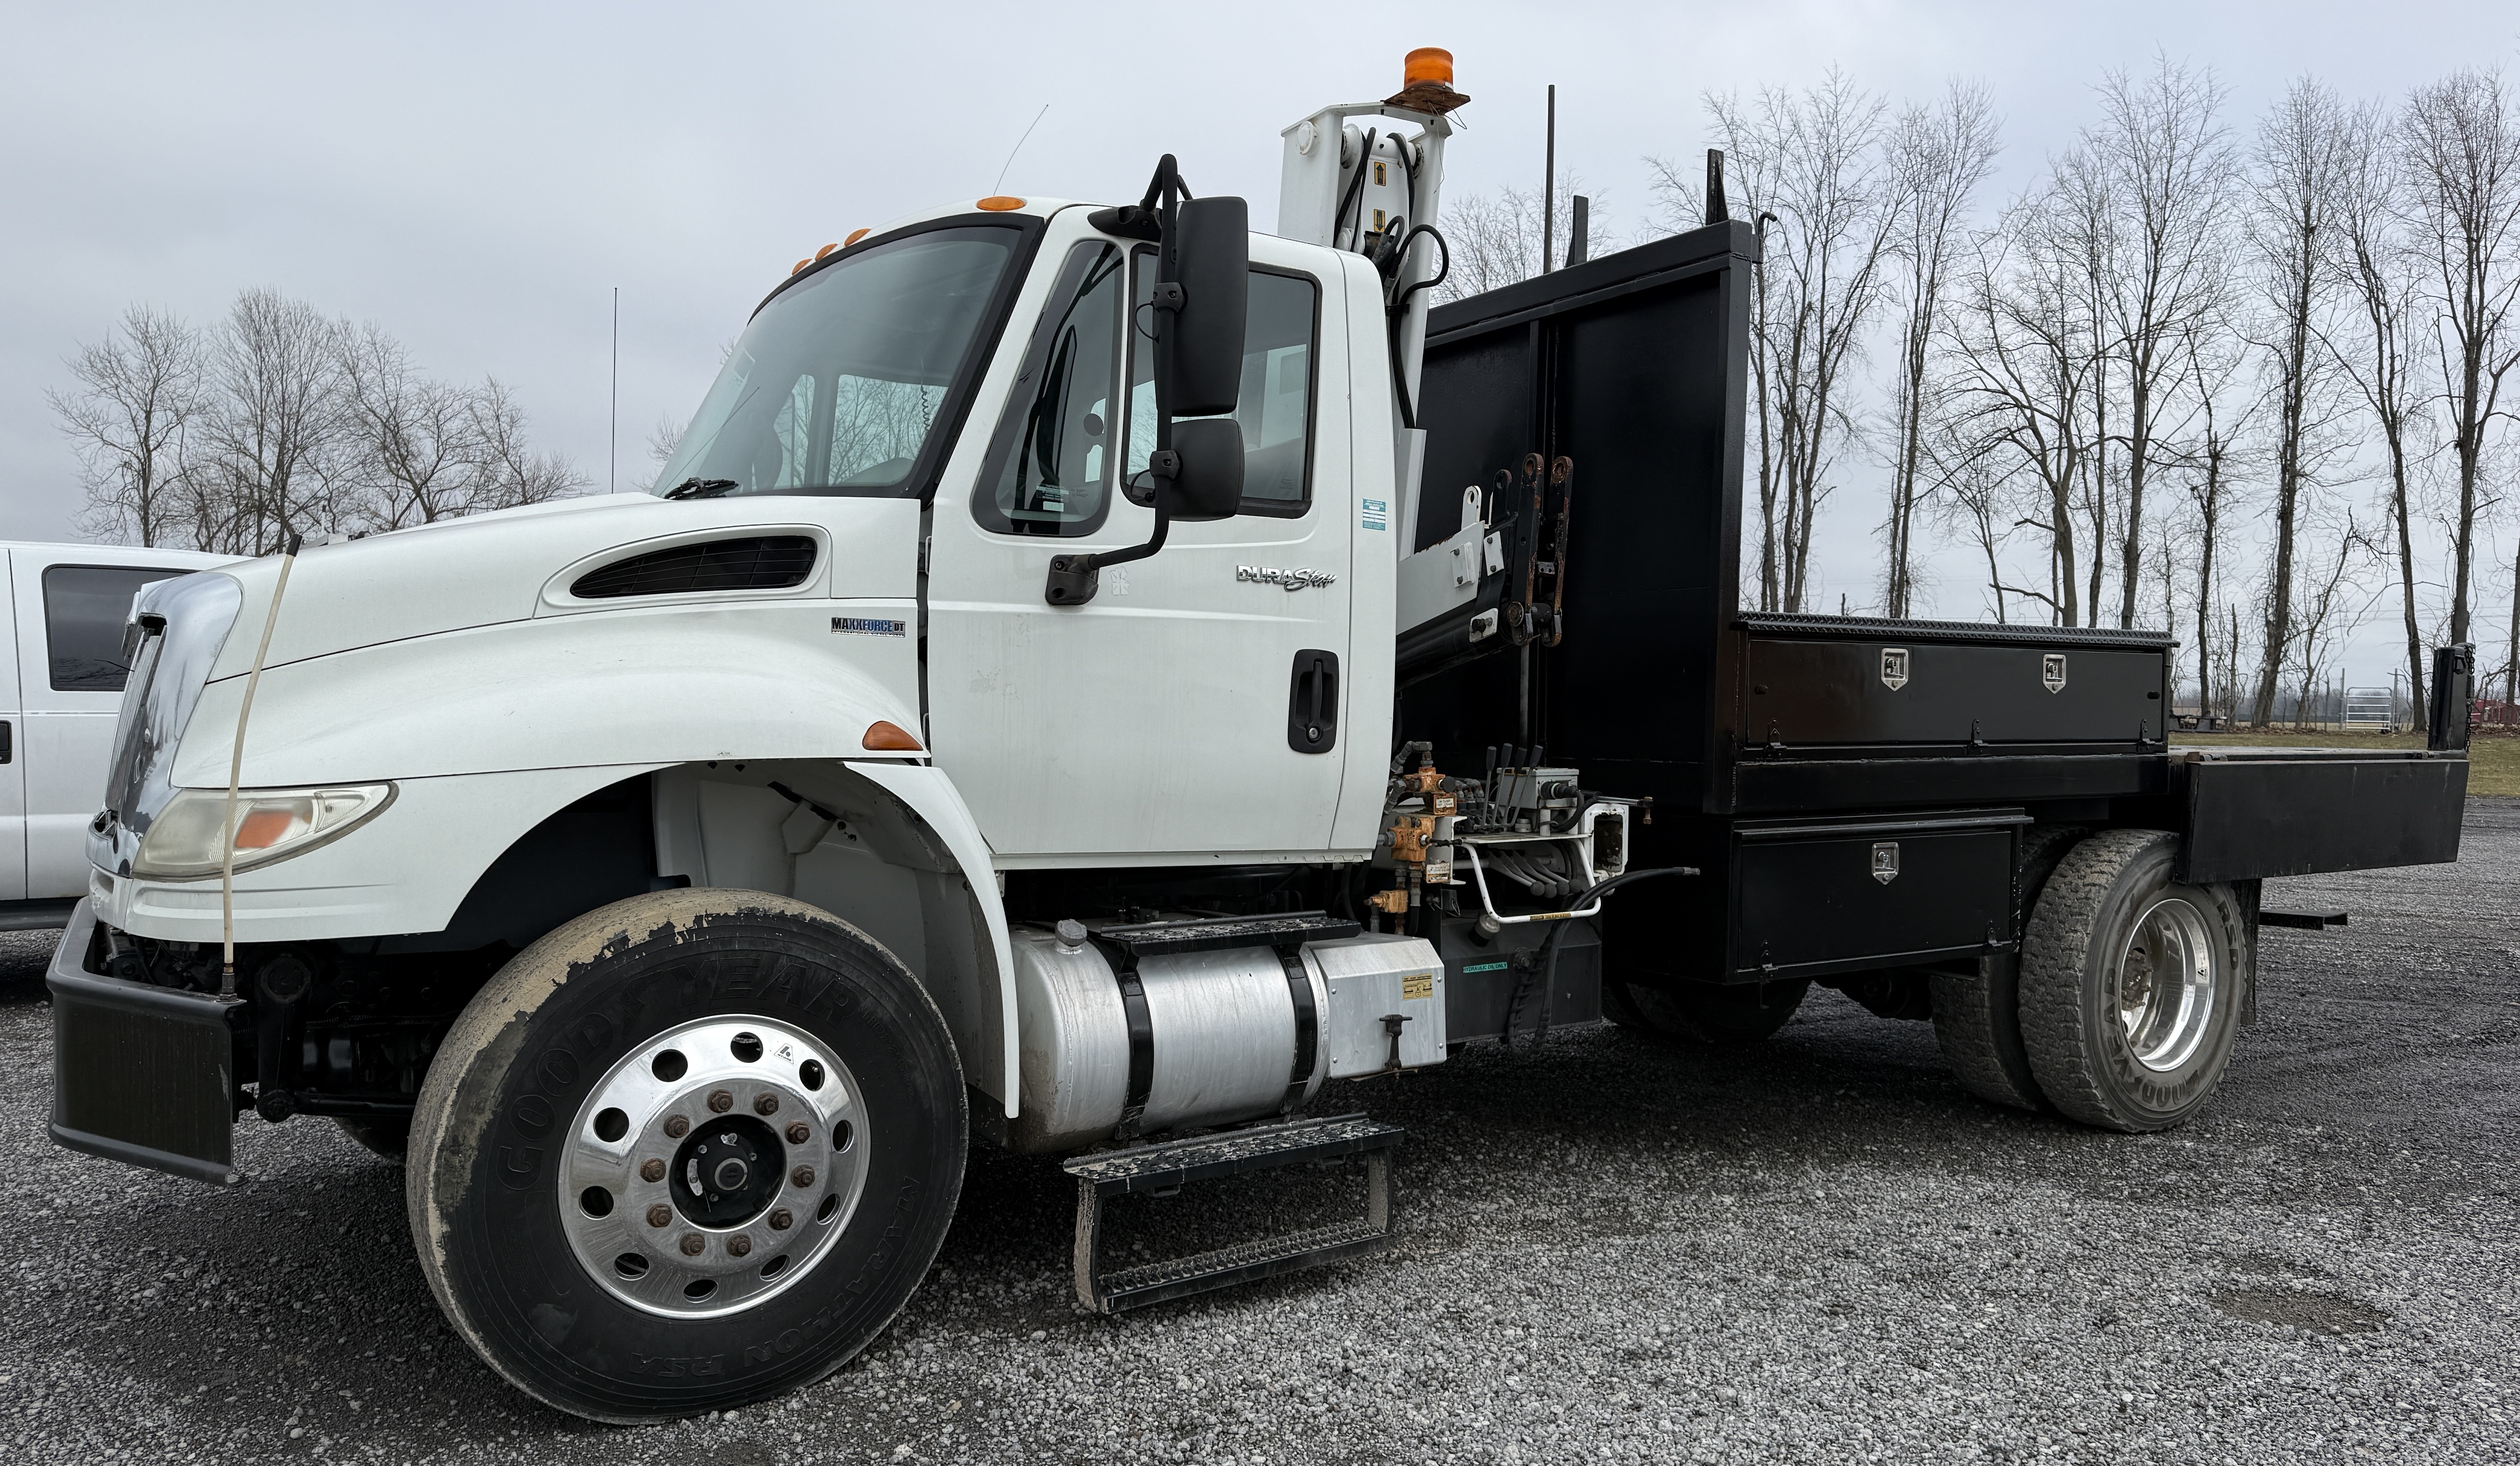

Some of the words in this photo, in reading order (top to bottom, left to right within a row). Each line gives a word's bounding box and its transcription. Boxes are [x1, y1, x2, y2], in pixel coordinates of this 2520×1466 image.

[832, 617, 892, 632] MAXXFORCE
[894, 623, 904, 631] DT
[496, 957, 860, 1191] GOODYEAR
[744, 1175, 920, 1367] MARATHON
[629, 1352, 725, 1378] RSA
